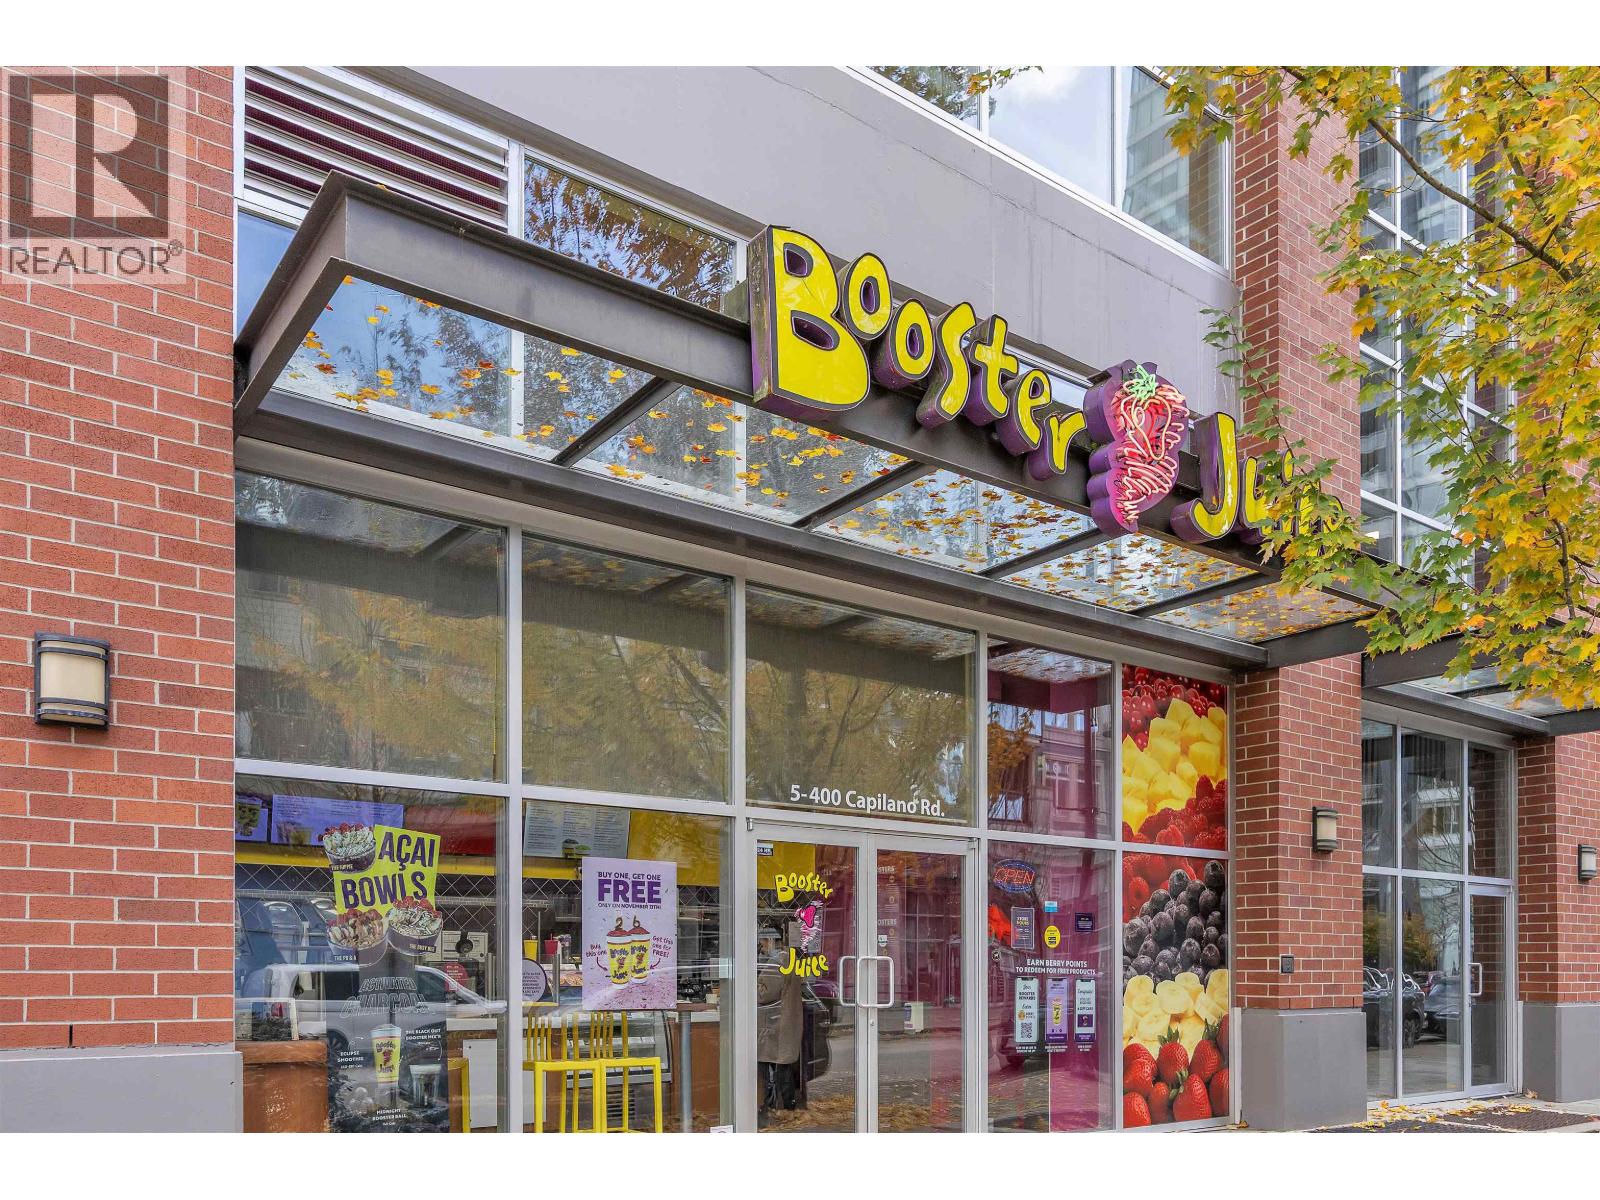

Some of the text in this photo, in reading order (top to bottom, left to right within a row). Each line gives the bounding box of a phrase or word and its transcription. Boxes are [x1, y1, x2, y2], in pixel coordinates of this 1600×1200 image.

[752, 226, 1087, 478] Booster
[790, 785, 945, 817] 5-400 Capilano Rd.
[378, 831, 436, 871] AÇAI
[774, 872, 833, 902] Booster
[993, 867, 1036, 885] OPEN
[598, 879, 661, 904] FREE
[778, 948, 829, 977] Juice
[1026, 958, 1088, 968] EARN BERRY POINTS
